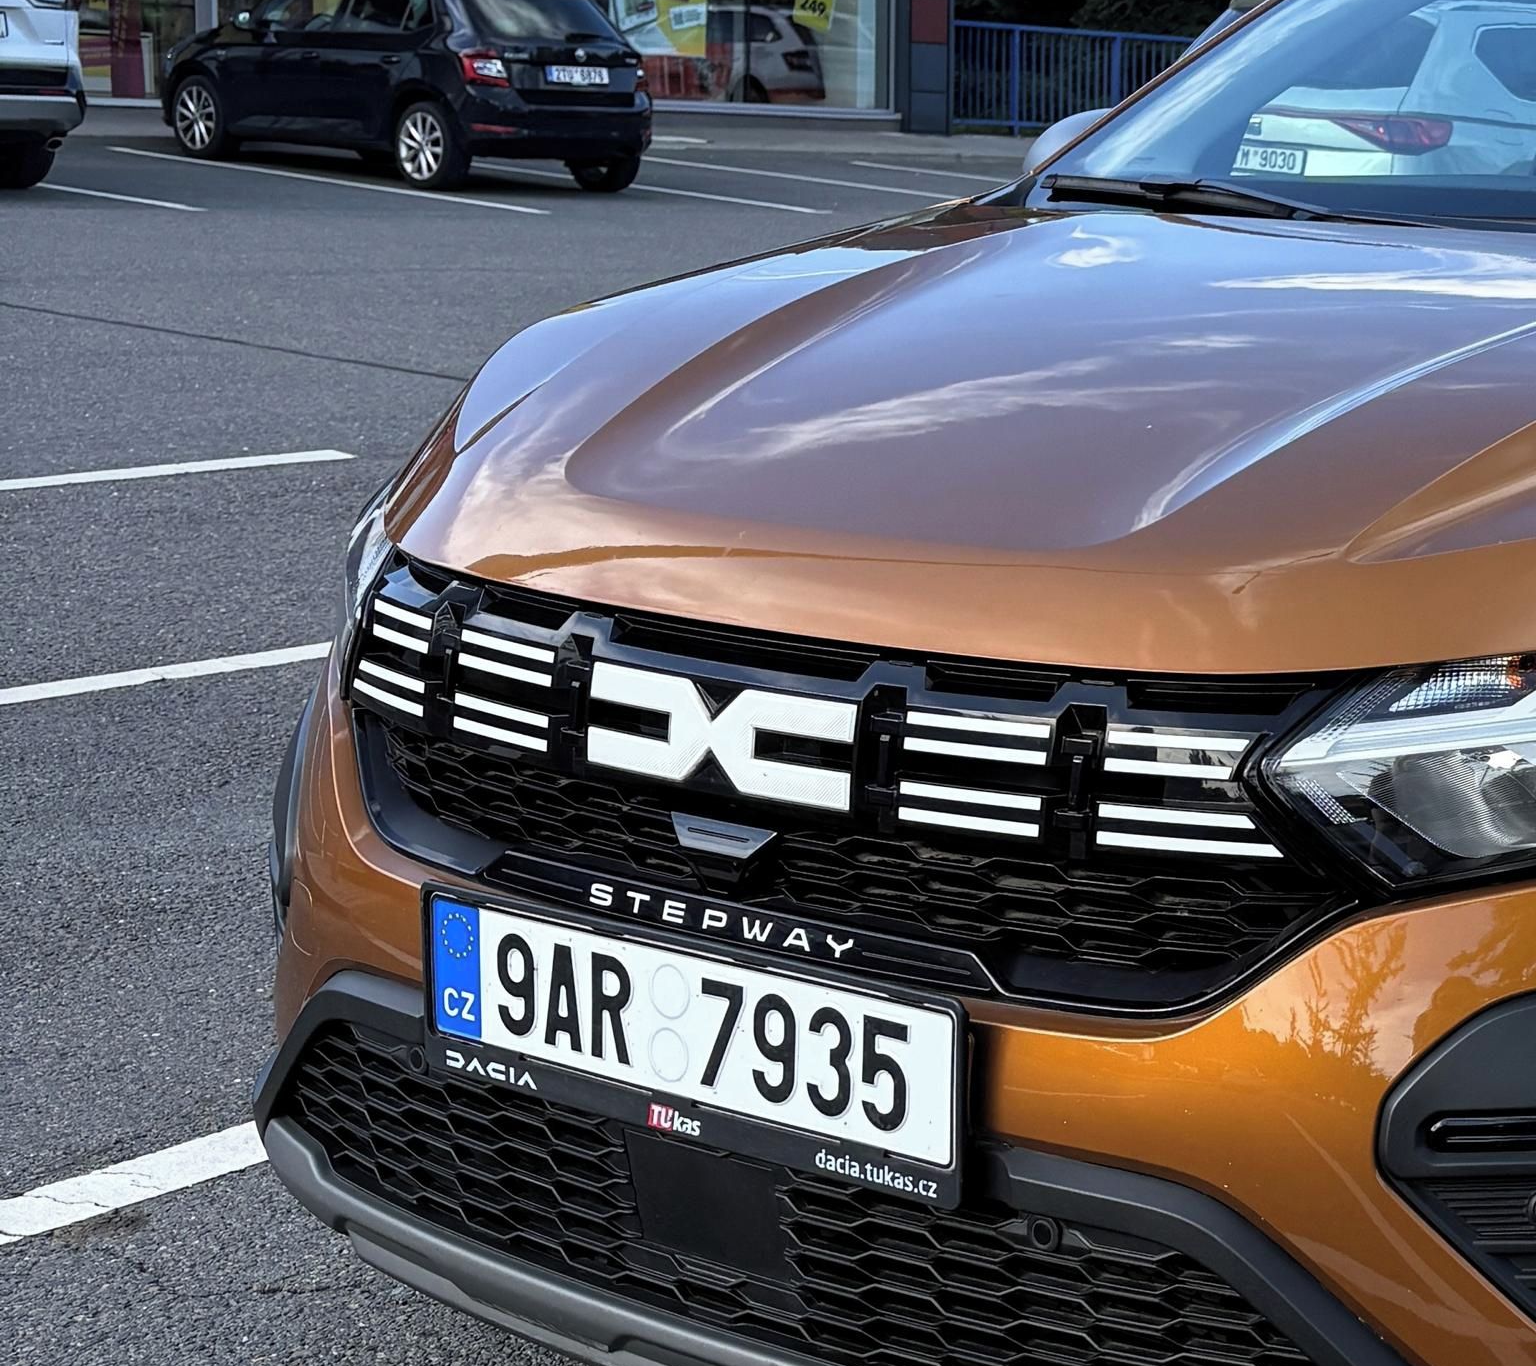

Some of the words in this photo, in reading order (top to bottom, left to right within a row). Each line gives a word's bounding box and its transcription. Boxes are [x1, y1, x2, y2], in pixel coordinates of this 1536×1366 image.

[1259, 149, 1297, 171] 9030
[588, 882, 855, 959] STEPWAY
[443, 986, 476, 1022] CZ
[497, 933, 632, 1067] 9AR
[700, 977, 909, 1132] 7935
[445, 1049, 538, 1091] DACIA
[814, 1148, 938, 1199] dacia.tukas.cz
